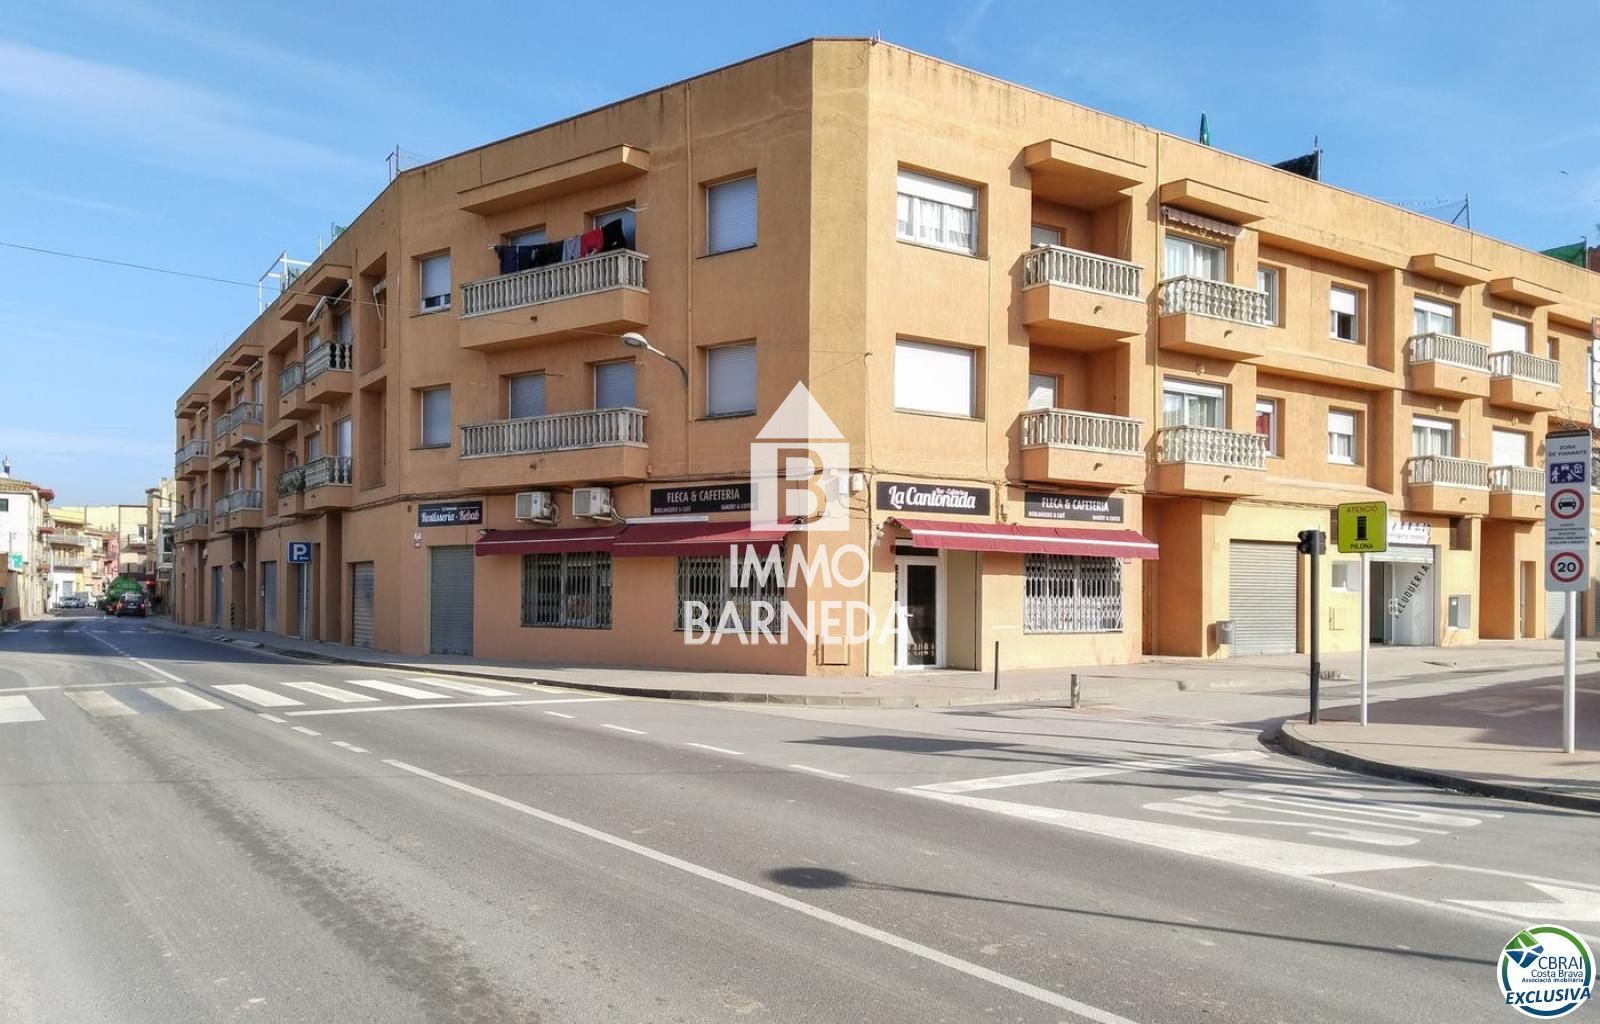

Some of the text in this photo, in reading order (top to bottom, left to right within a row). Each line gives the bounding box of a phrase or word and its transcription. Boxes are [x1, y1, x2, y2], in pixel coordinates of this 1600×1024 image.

[667, 488, 740, 503] FLECA & CAFETERIA
[888, 485, 977, 510] La Cantonada
[1041, 497, 1109, 512] FLECA & CAFETERIA
[1557, 561, 1577, 573] 20
